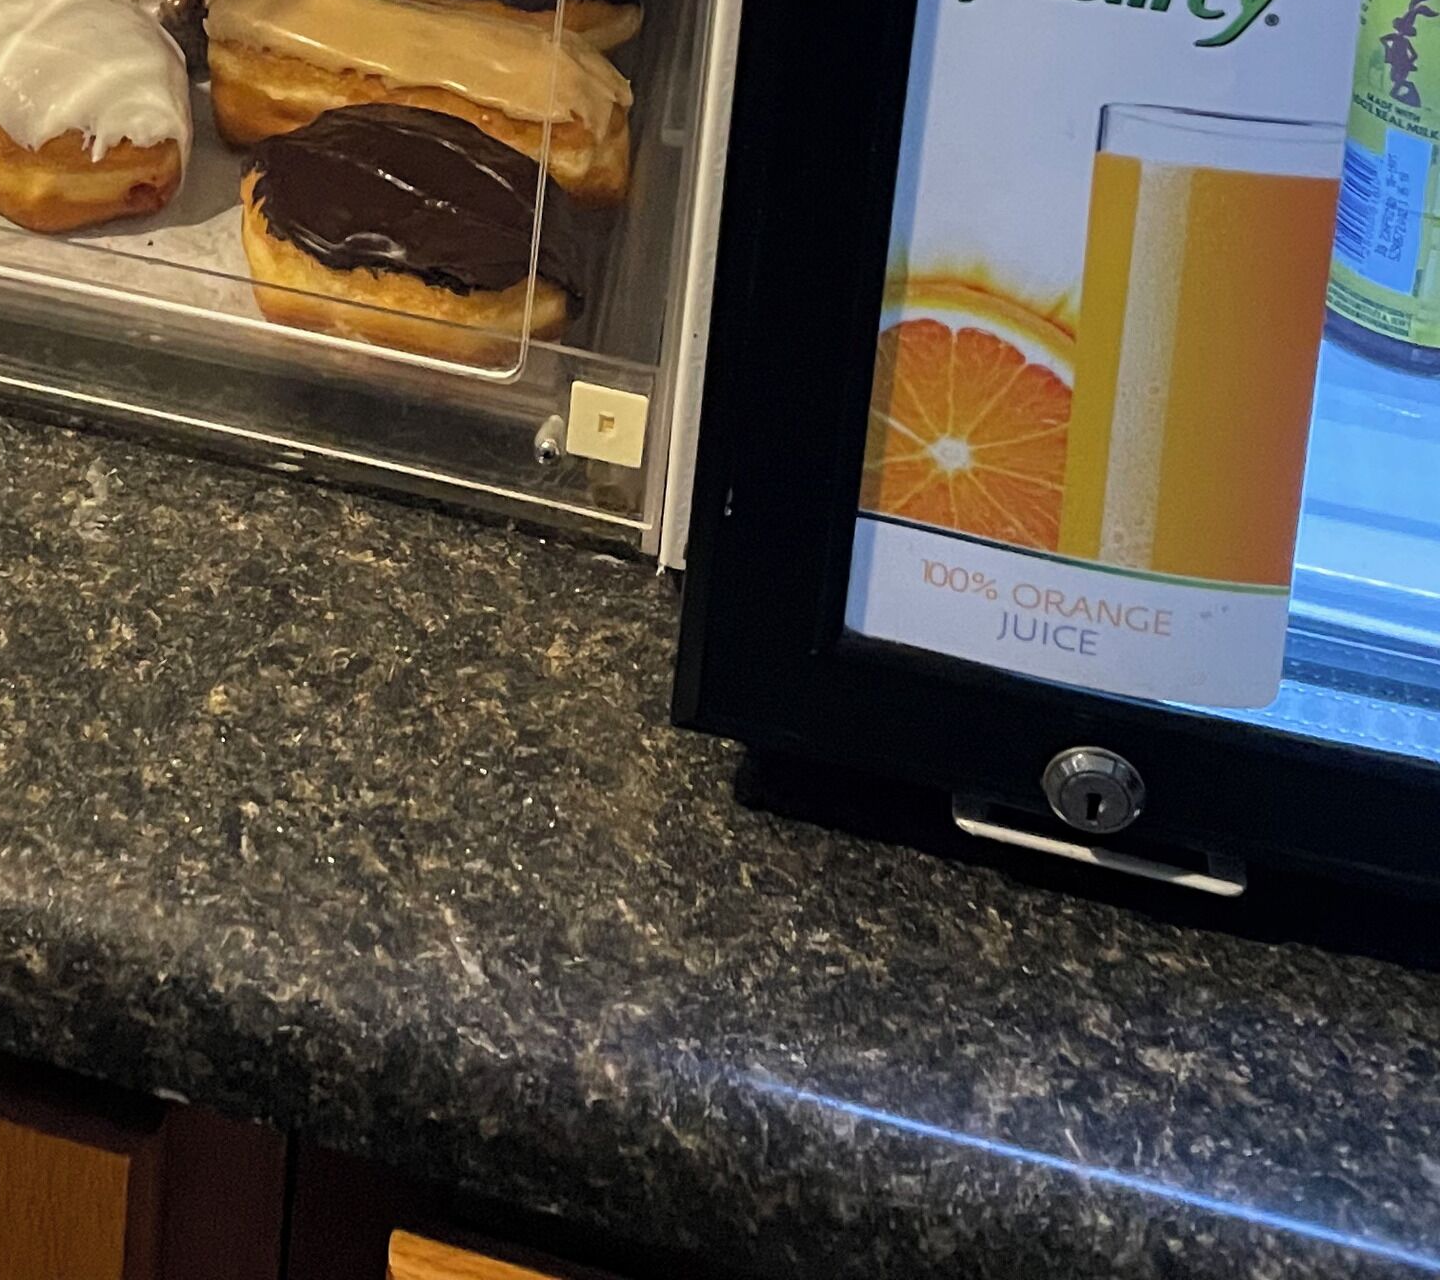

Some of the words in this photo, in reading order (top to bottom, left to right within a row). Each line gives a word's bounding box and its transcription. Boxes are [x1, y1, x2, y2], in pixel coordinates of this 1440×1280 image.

[920, 558, 999, 602] 100%
[1013, 582, 1174, 637] ORANGE
[996, 611, 1099, 657] JUICE
